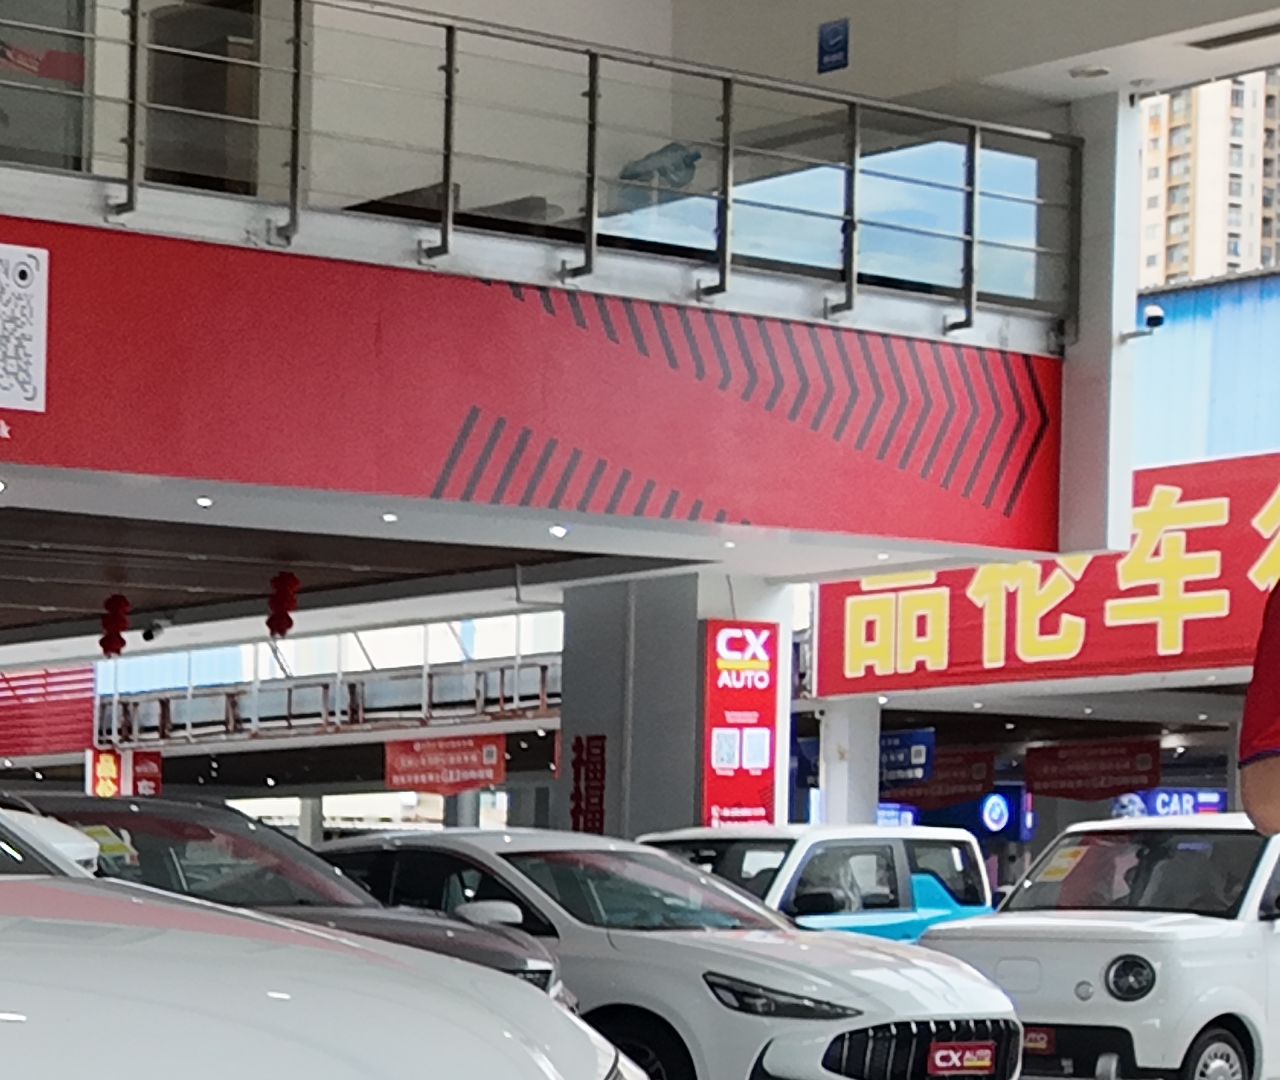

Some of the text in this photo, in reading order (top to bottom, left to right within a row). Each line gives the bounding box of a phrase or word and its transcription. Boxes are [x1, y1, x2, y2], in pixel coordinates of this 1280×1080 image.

[716, 628, 770, 661] CX
[717, 669, 770, 690] AUTO
[1155, 793, 1196, 816] CAR
[935, 1049, 961, 1067] CX
